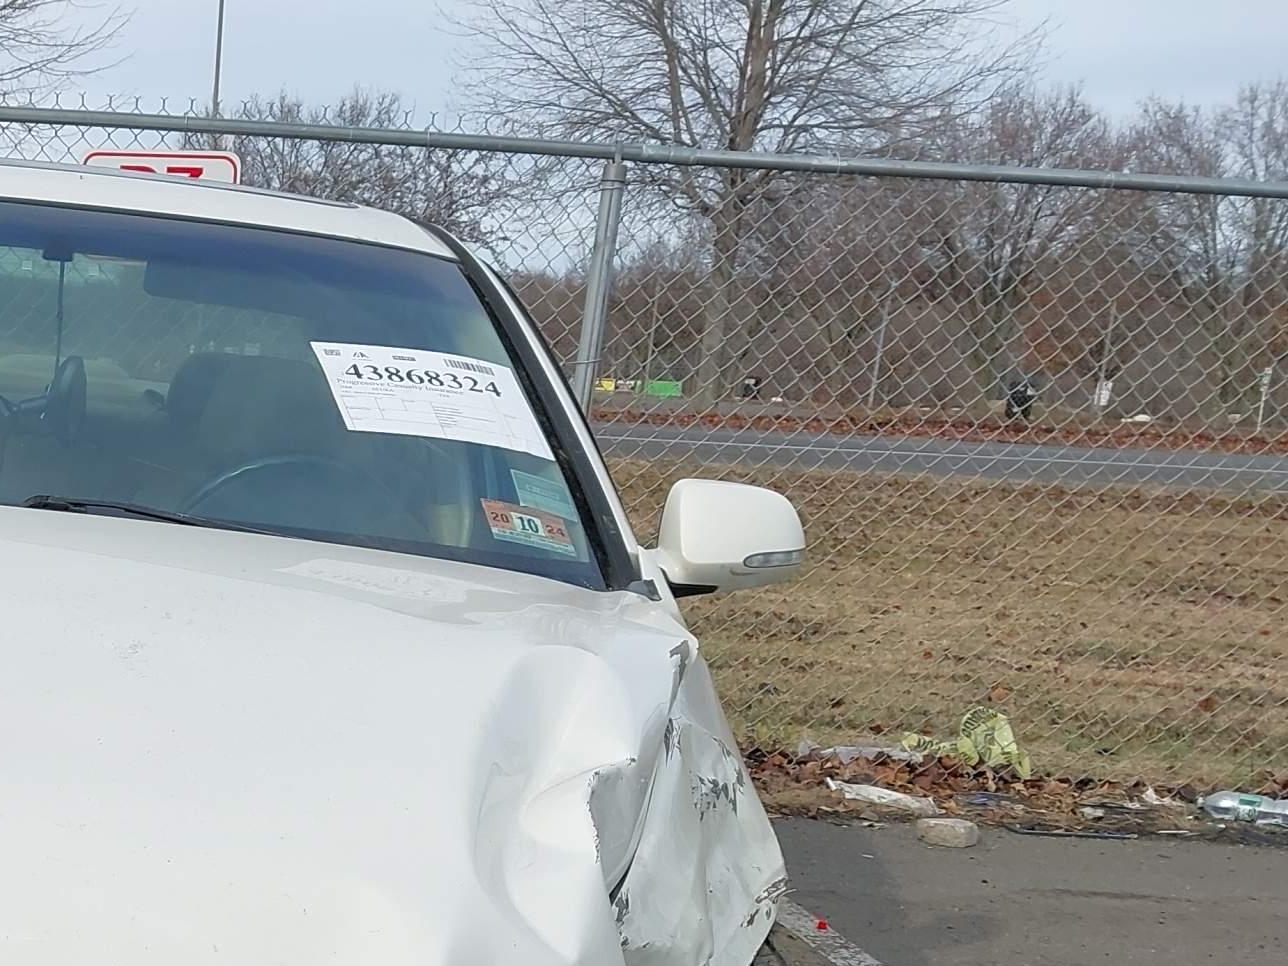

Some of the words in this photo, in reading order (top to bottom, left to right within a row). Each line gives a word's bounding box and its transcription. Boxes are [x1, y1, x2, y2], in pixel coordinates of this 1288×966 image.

[345, 363, 502, 397] 43868324
[491, 511, 510, 524] 20
[516, 516, 540, 534] 10
[546, 524, 566, 537] 24
